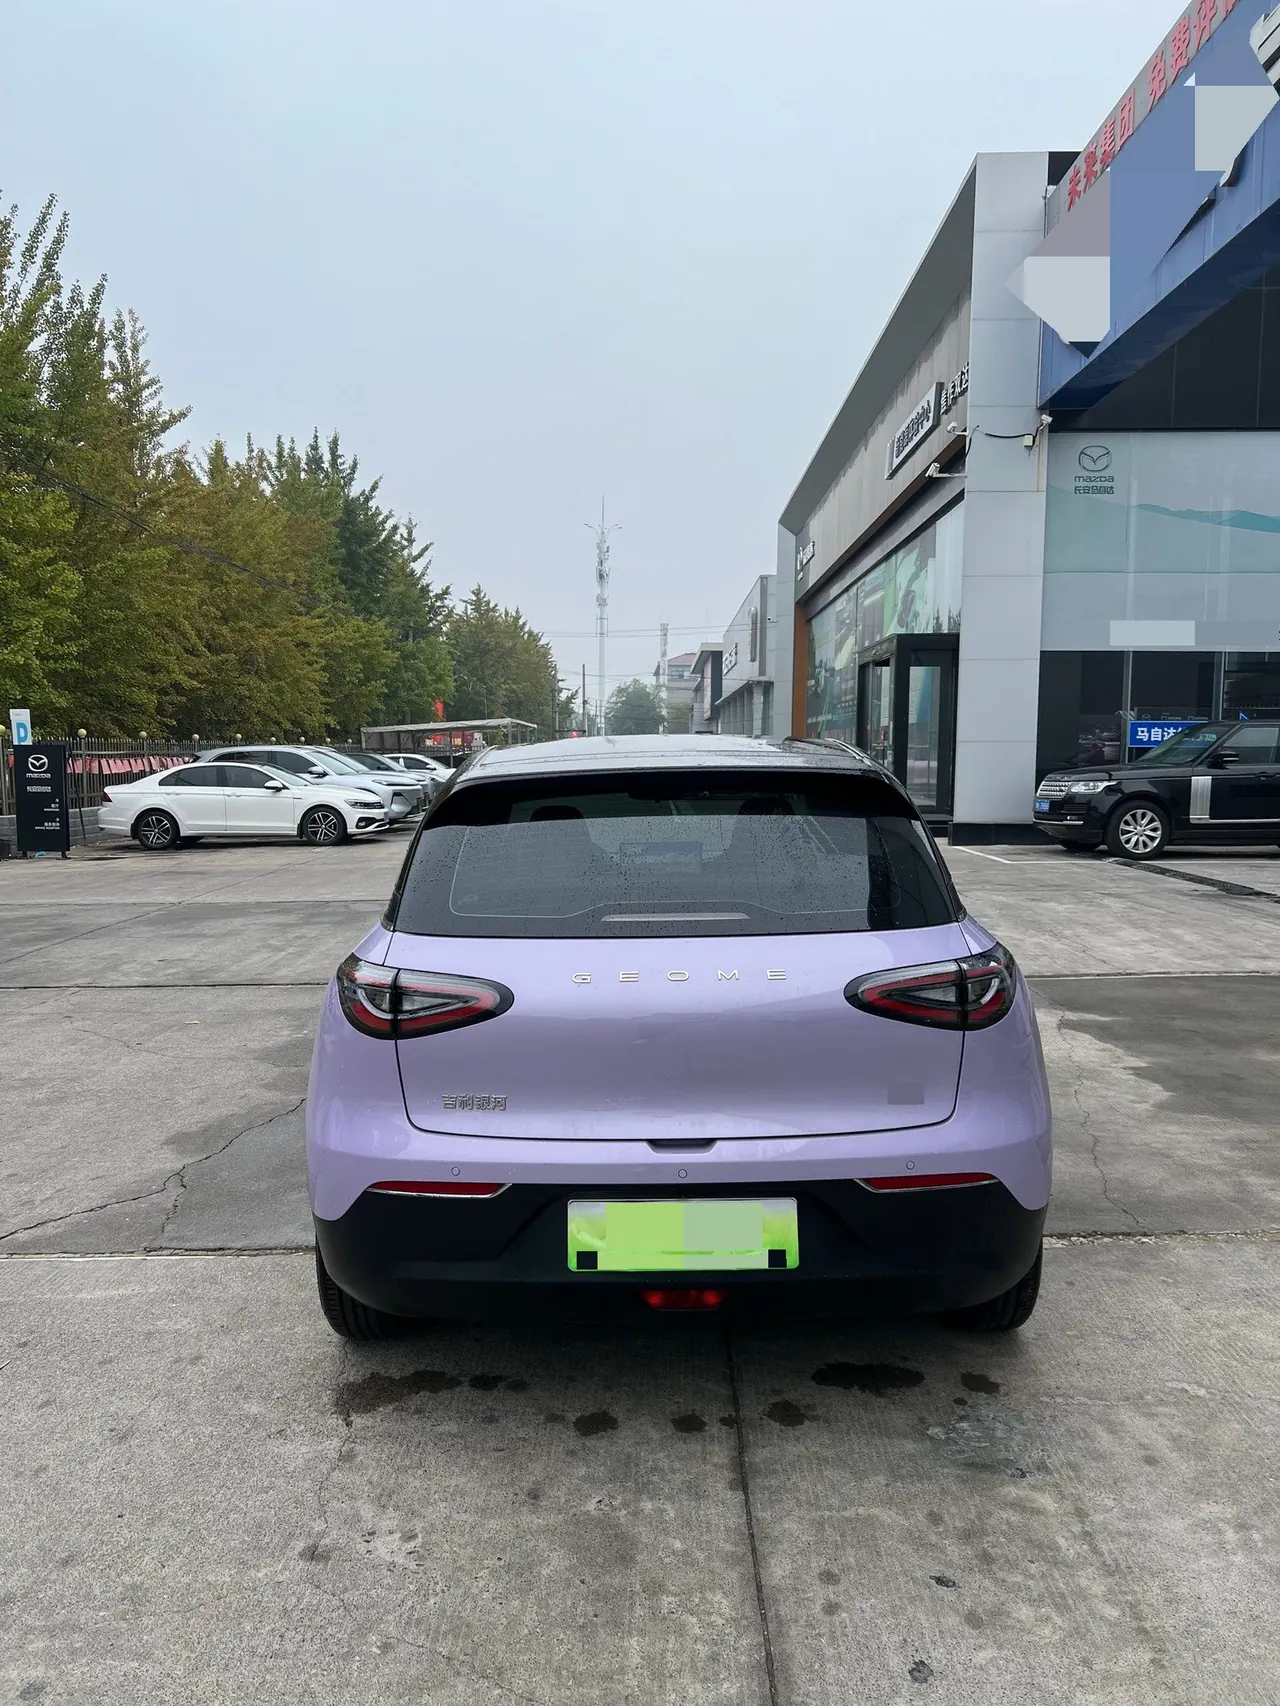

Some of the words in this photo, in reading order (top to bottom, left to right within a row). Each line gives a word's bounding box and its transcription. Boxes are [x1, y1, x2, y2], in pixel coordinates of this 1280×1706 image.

[1074, 486, 1114, 494] 长安马自达
[572, 969, 787, 984] GEOME
[442, 1094, 507, 1111] 吉利银河
